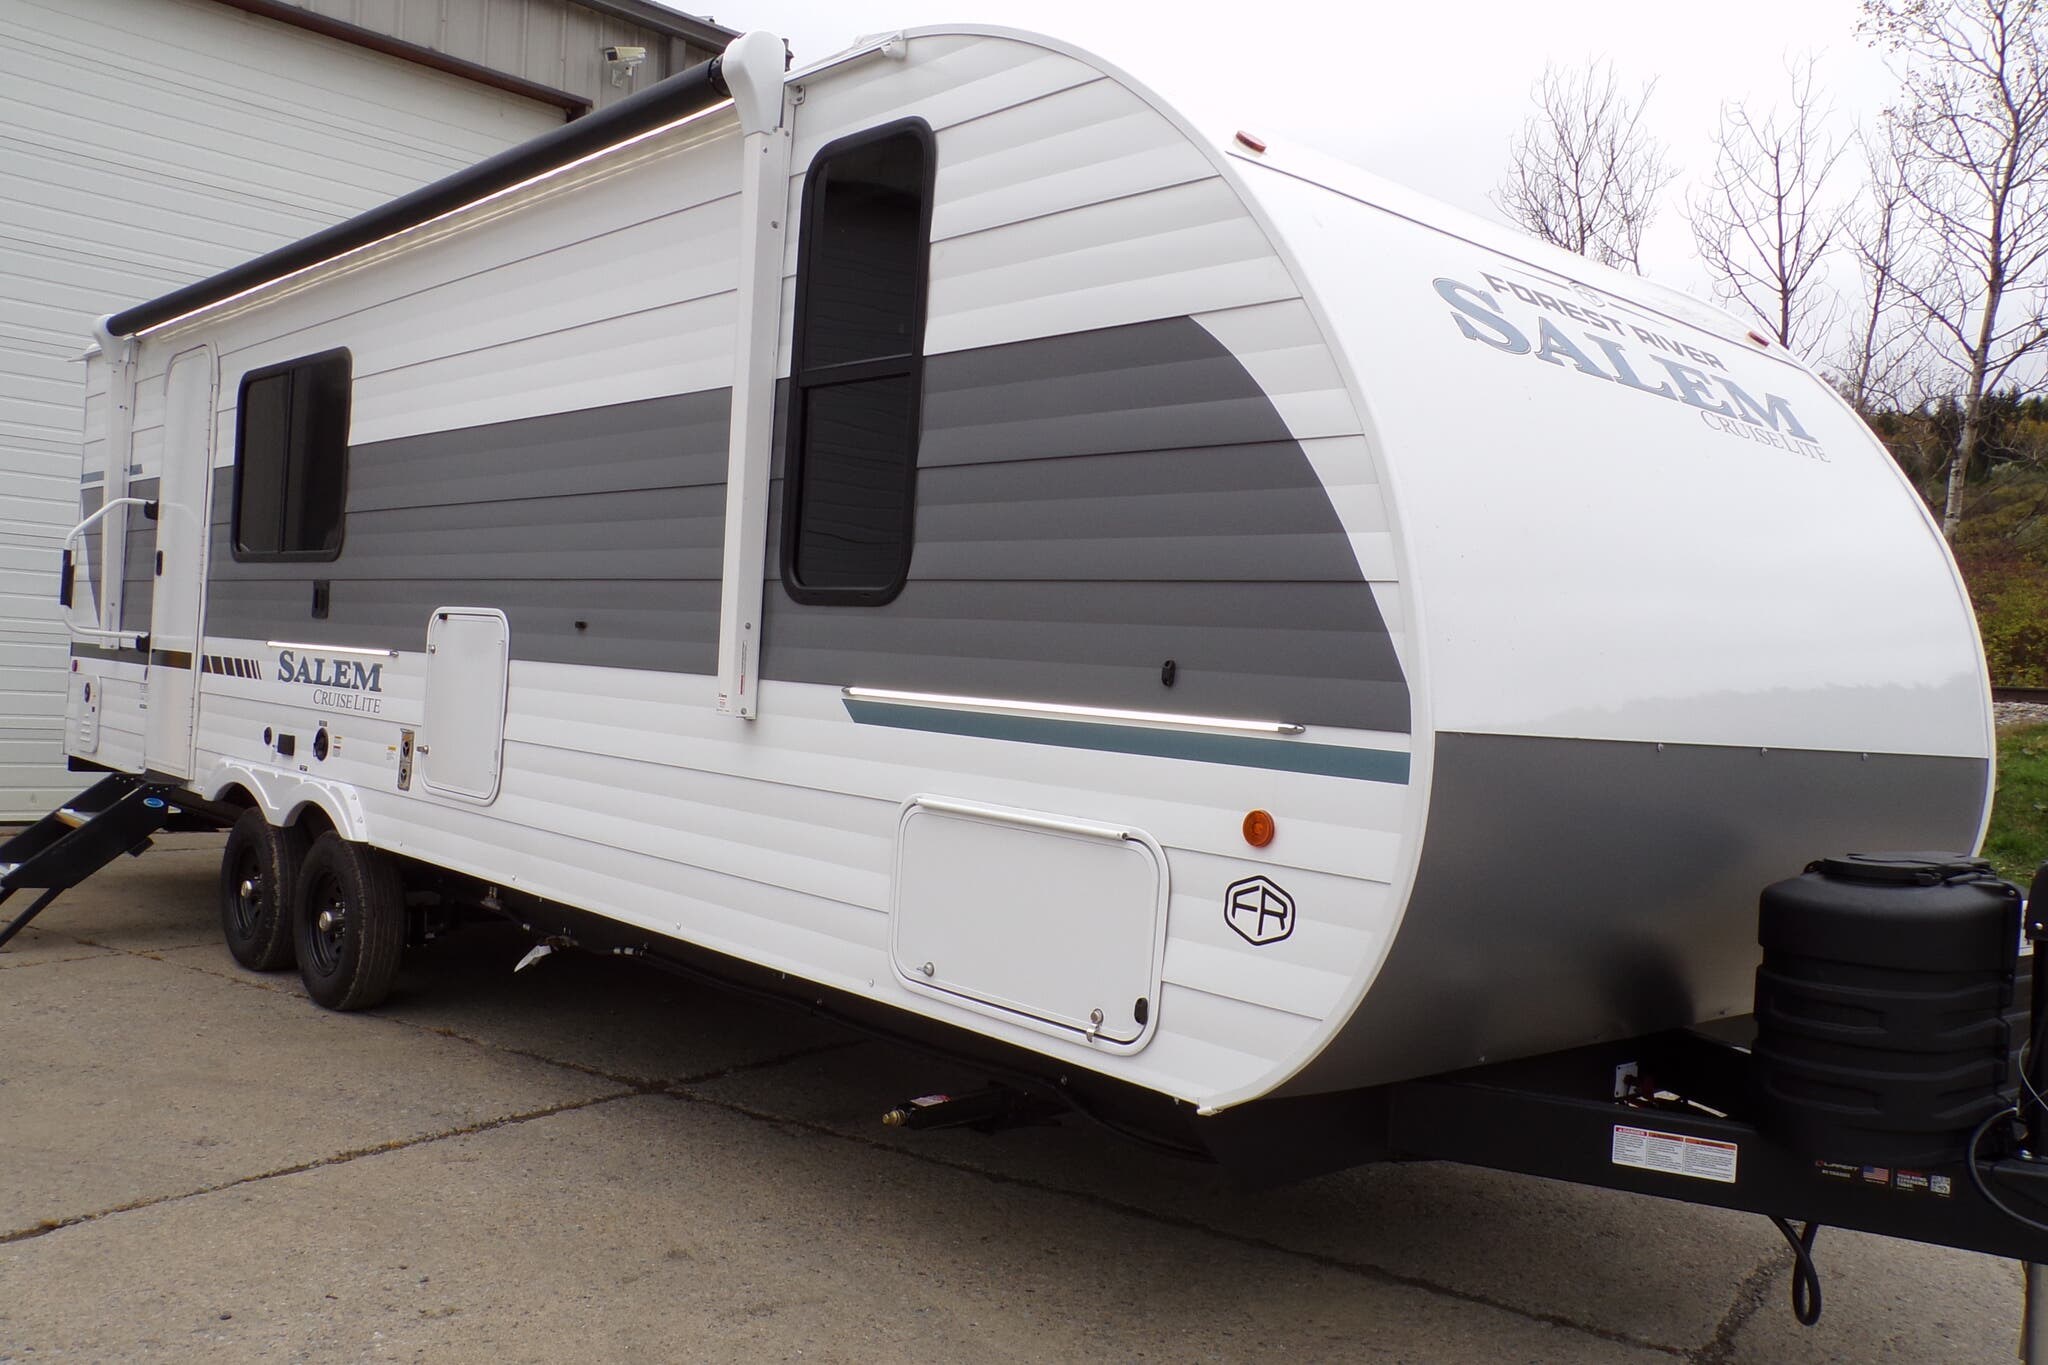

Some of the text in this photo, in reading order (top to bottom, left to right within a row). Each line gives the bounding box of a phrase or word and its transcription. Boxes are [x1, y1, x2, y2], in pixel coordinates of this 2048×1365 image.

[1433, 277, 1819, 444] SALEM
[1480, 271, 1729, 373] FOREST RIVER
[278, 649, 383, 693] SALEM
